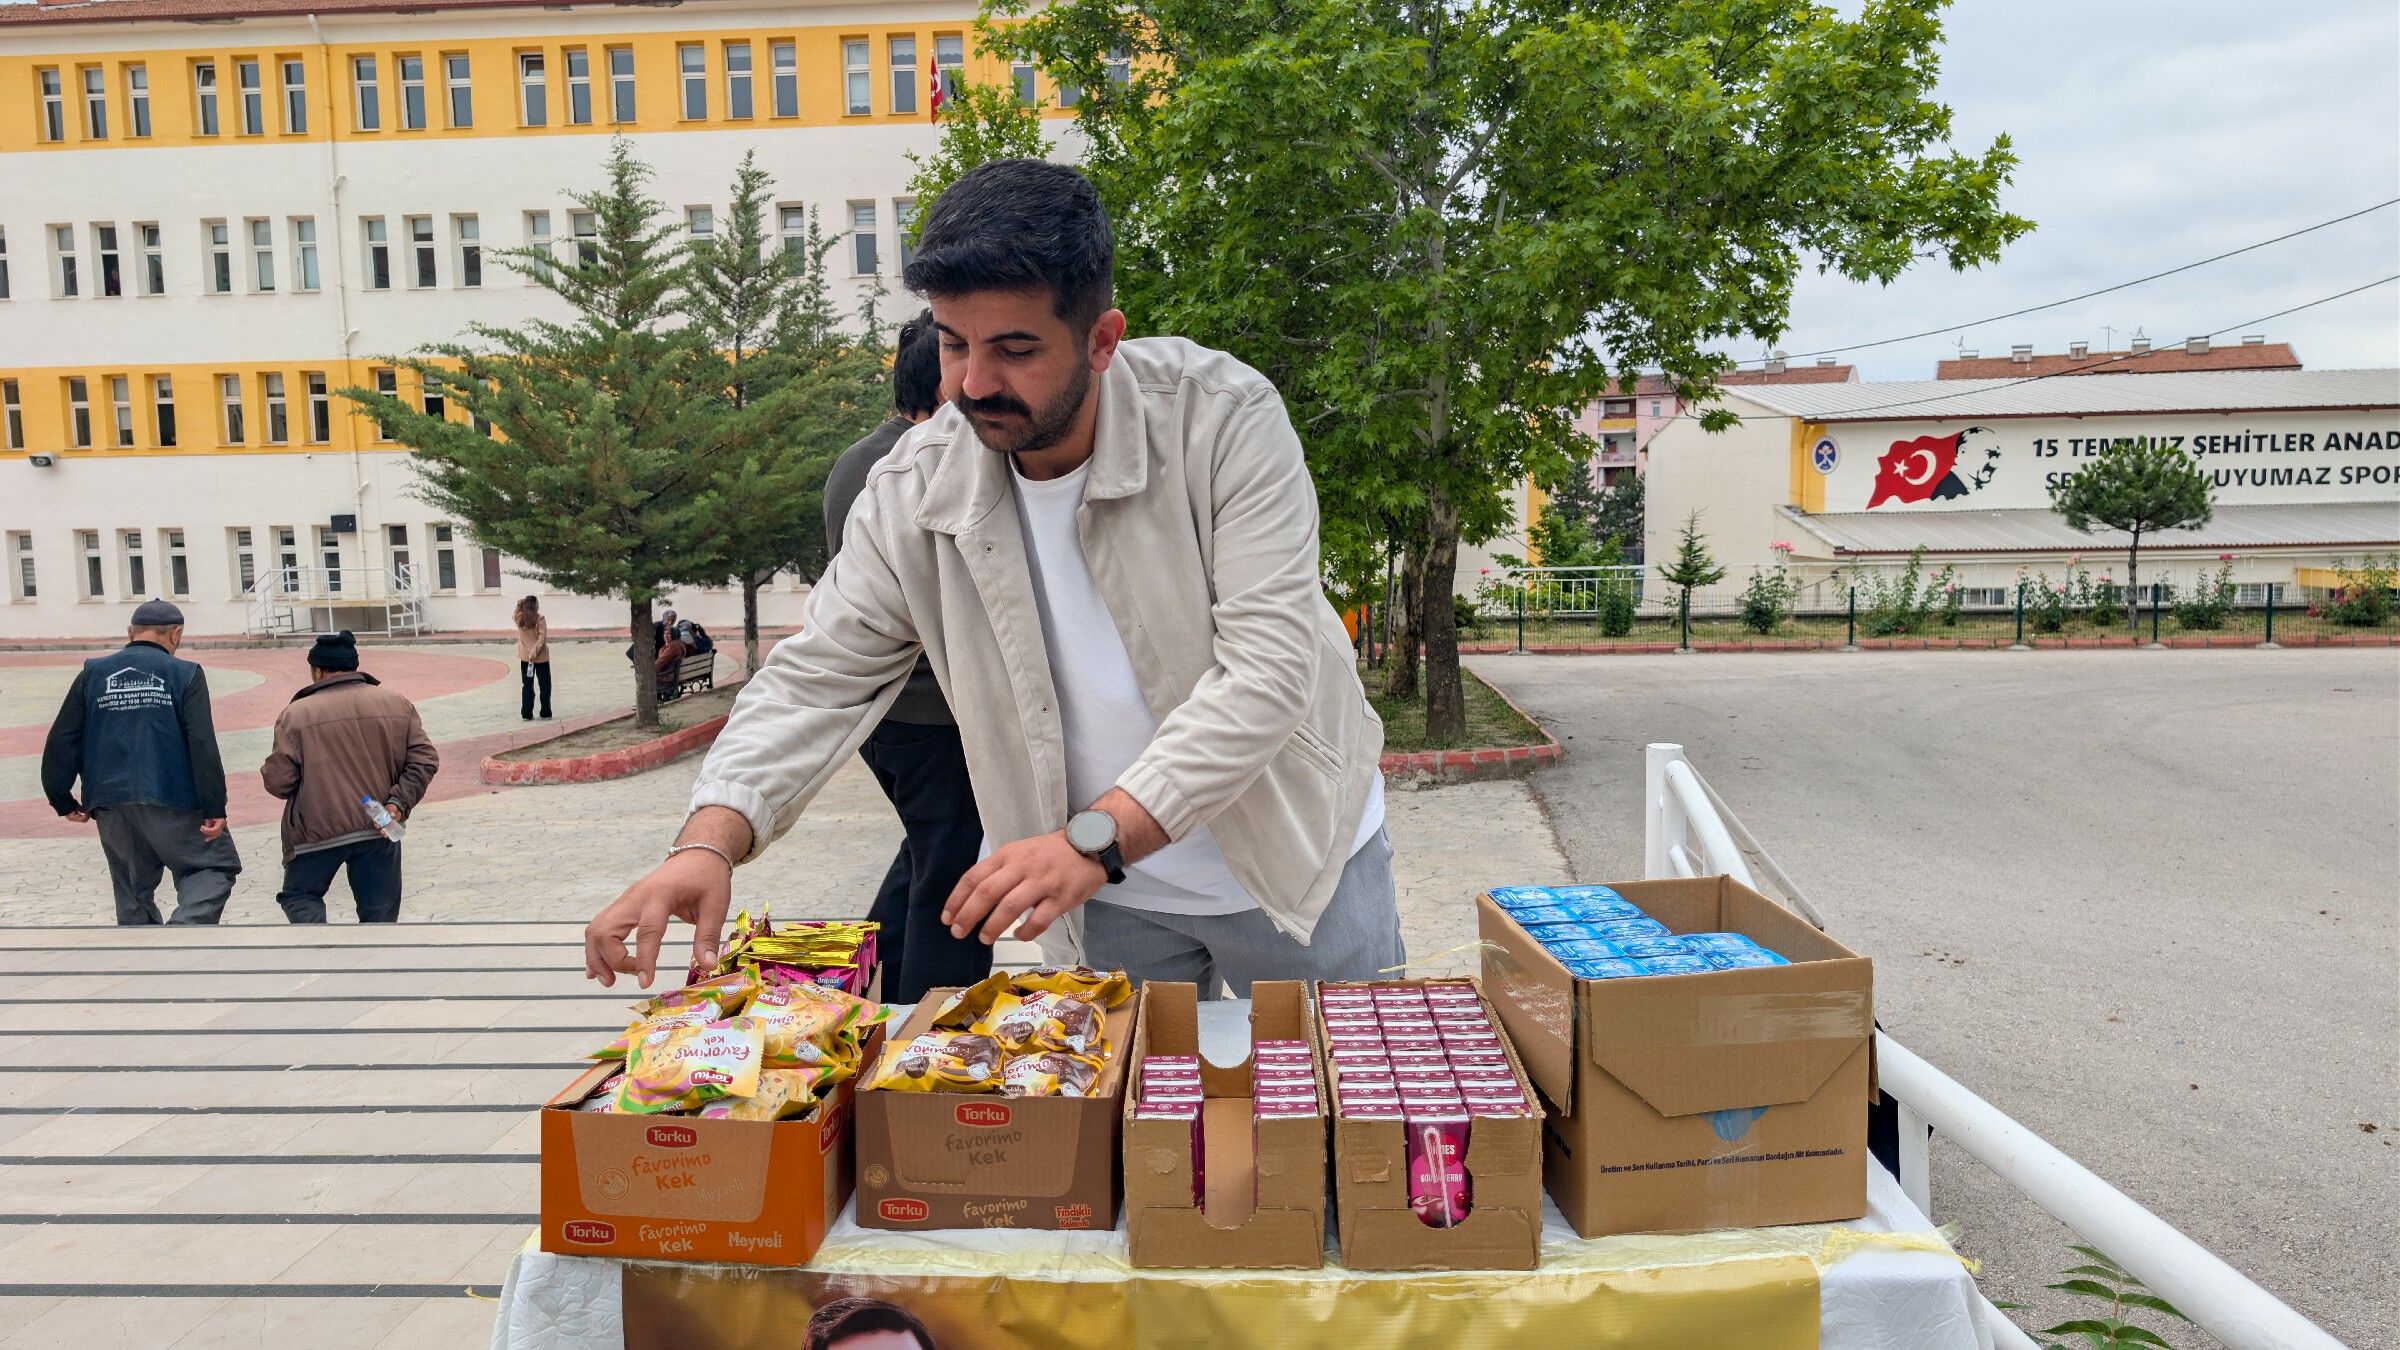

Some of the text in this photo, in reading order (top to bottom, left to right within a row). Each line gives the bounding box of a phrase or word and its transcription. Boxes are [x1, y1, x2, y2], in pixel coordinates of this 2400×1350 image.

[2032, 438, 2059, 457] 15
[2192, 429, 2315, 460] ŞEHİTLER
[2213, 467, 2332, 487] UYUMAZ
[704, 1035, 725, 1046] Kek
[694, 1071, 729, 1084] Torku
[961, 1107, 1006, 1121] Torku
[650, 1128, 692, 1144] Torku
[945, 1129, 1023, 1152] favorimo
[631, 1152, 712, 1176] favorimo
[968, 1148, 1008, 1166] Kek
[655, 1172, 697, 1190] Kek
[884, 1203, 923, 1217] Torku
[962, 1198, 1028, 1219] favorimo
[982, 1214, 1016, 1228] Kek
[569, 1224, 610, 1240] Torku
[638, 1221, 707, 1241] favorimo
[659, 1238, 694, 1253] Kek
[727, 1230, 783, 1253] Meyveli
